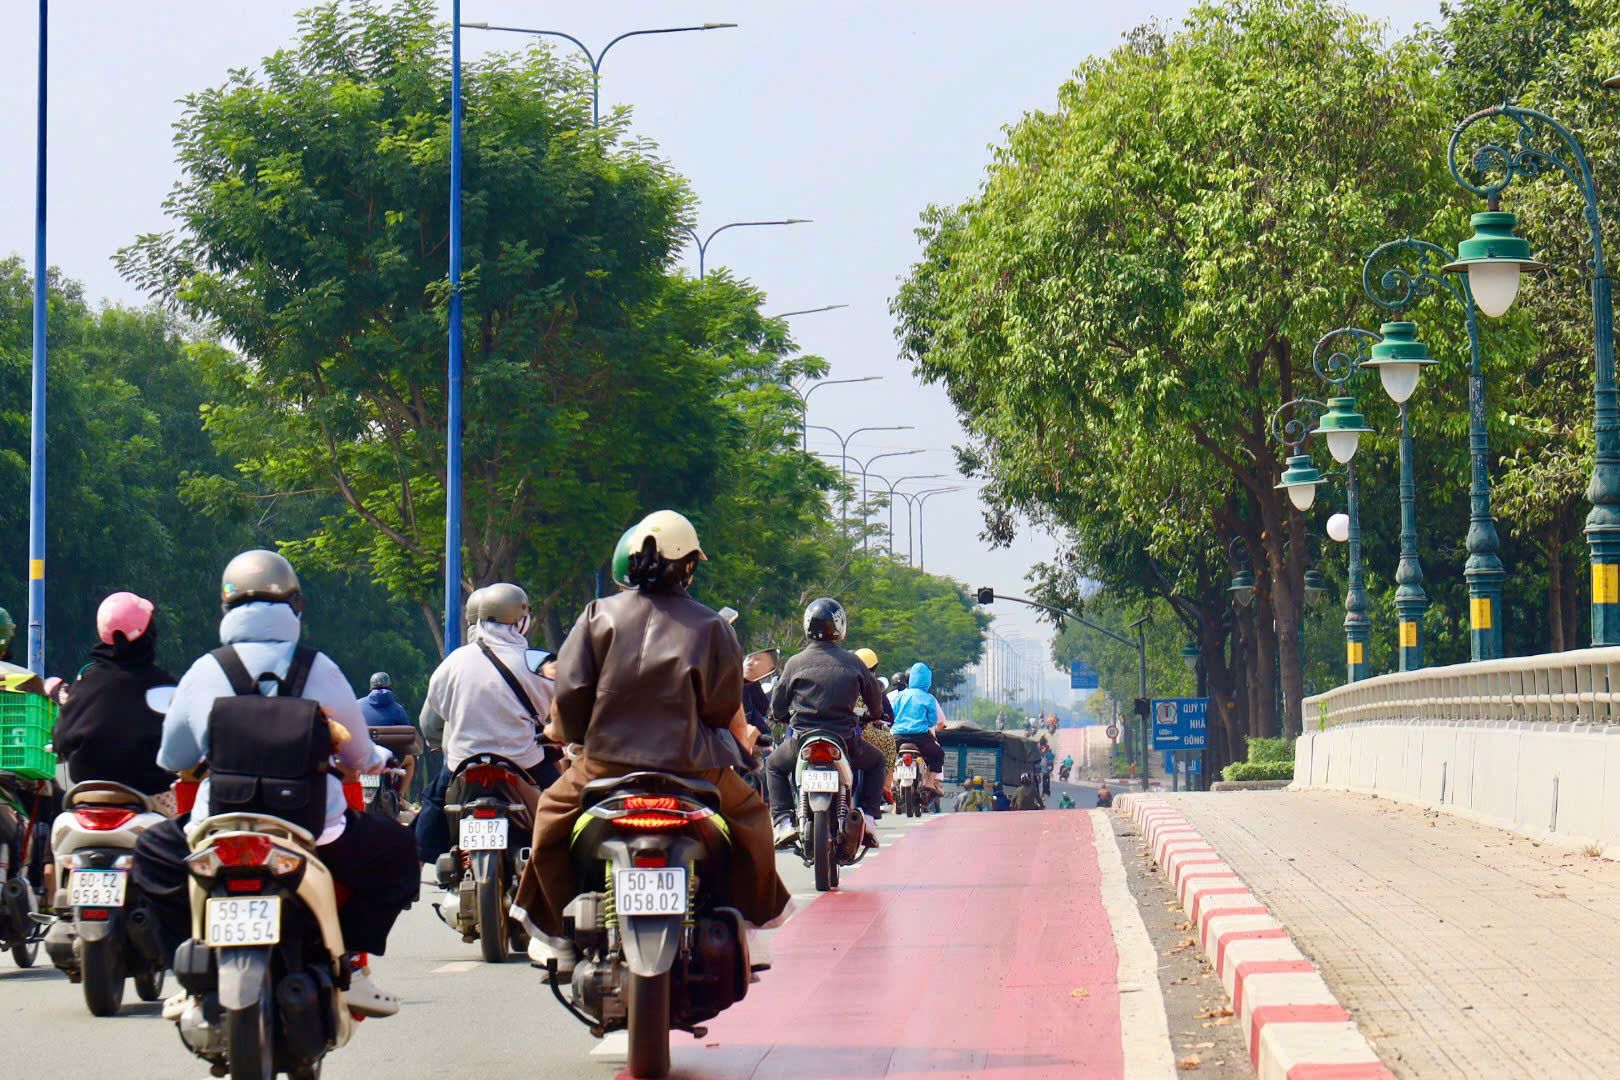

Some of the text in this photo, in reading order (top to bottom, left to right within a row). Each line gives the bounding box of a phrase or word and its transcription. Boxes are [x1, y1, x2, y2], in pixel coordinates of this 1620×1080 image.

[468, 821, 500, 834] 60-B7
[628, 872, 674, 890] 50-AD
[218, 900, 269, 920] 59-F2
[623, 892, 679, 911] 058.02
[211, 921, 274, 943] 065.54
